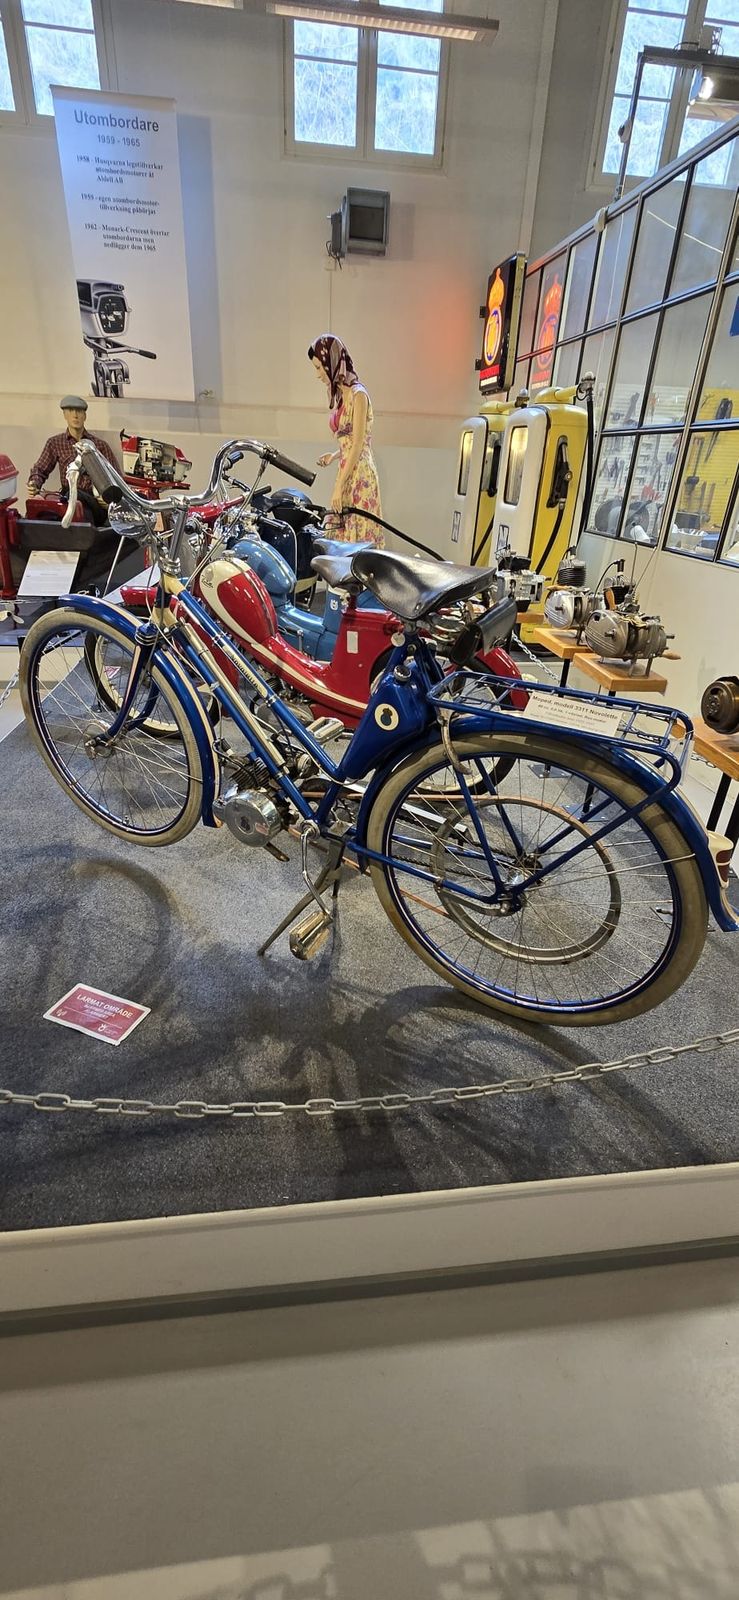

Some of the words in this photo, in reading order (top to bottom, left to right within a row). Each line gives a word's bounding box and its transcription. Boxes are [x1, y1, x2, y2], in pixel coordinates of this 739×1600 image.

[74, 109, 159, 132] Utombordare
[97, 134, 116, 145] 1959
[122, 137, 141, 148] 1965
[94, 156, 126, 166] Husqvarna
[99, 204, 131, 214] tillverkning
[102, 224, 149, 234] Monark-Crescent
[103, 242, 130, 250] nedlägger
[532, 695, 553, 705] Moped,
[553, 701, 574, 710] modell
[589, 709, 618, 720] Novolette
